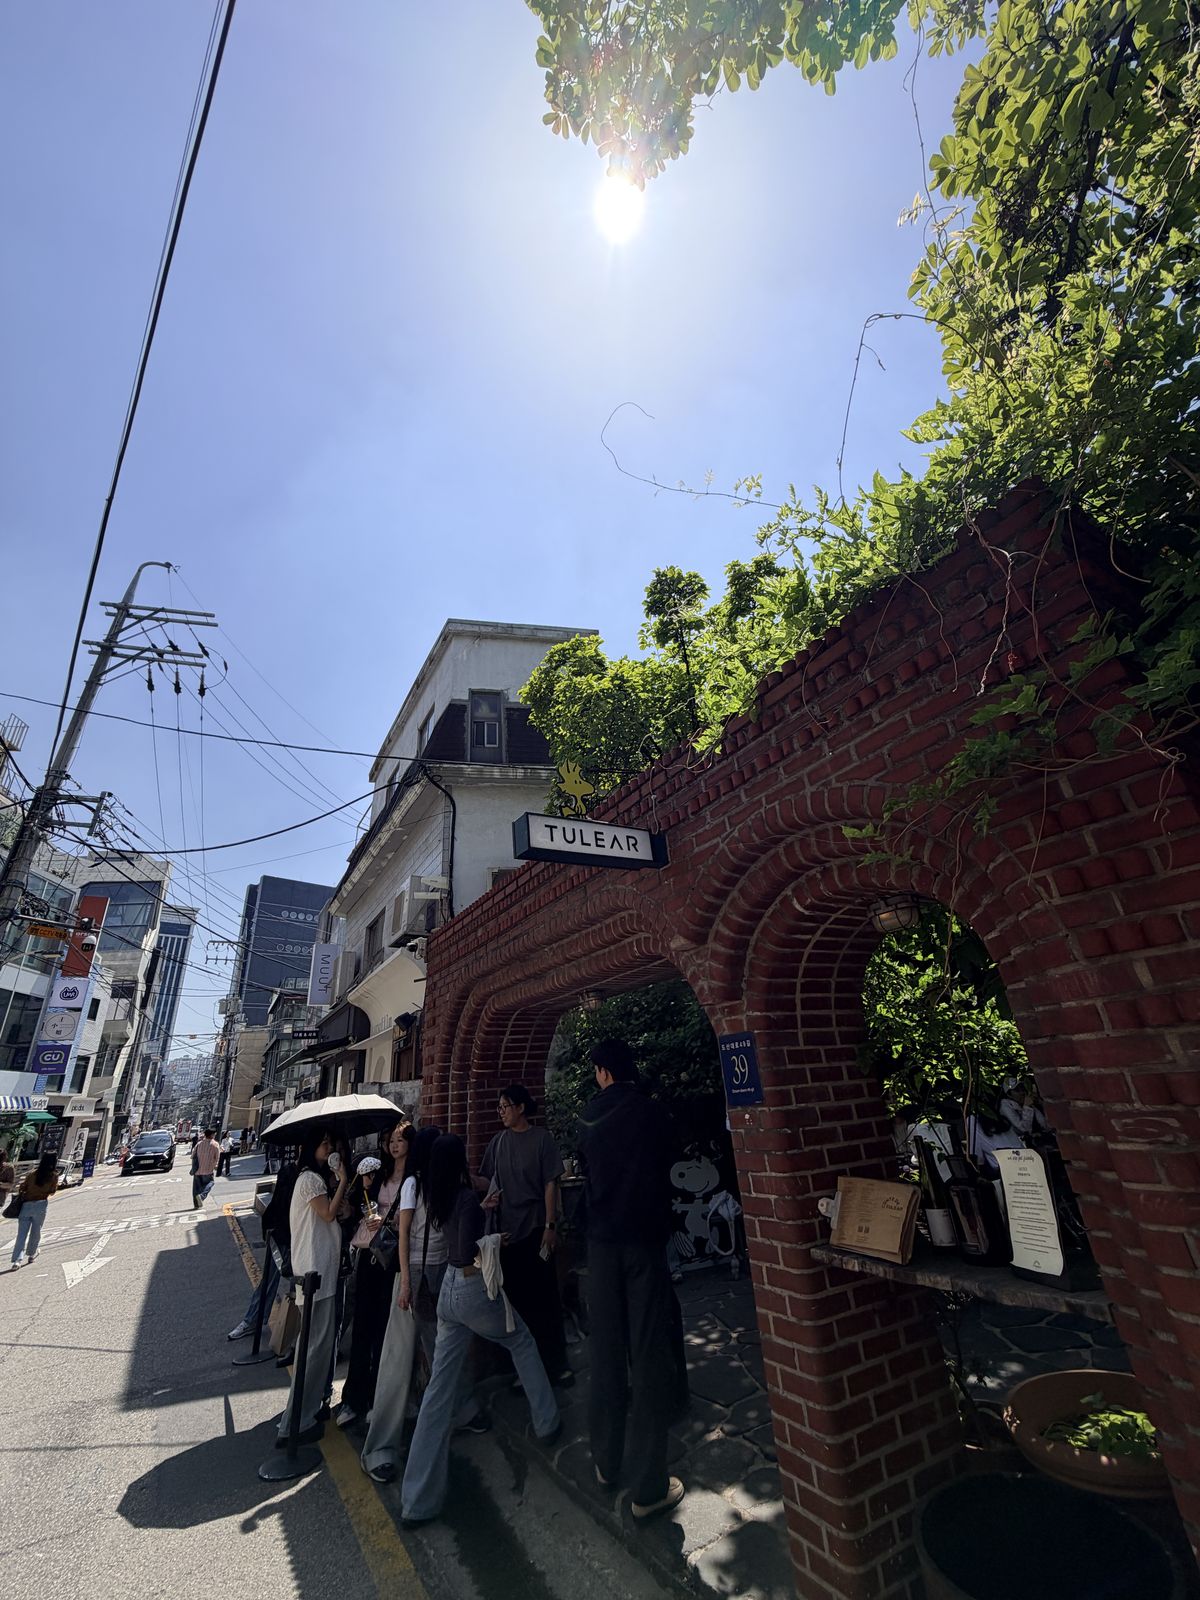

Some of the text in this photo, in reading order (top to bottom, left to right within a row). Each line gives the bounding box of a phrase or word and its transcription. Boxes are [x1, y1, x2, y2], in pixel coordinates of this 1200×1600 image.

[544, 824, 639, 853] TULEAR
[317, 954, 331, 993] MUUT
[43, 1053, 61, 1061] CU
[730, 1053, 749, 1085] 39
